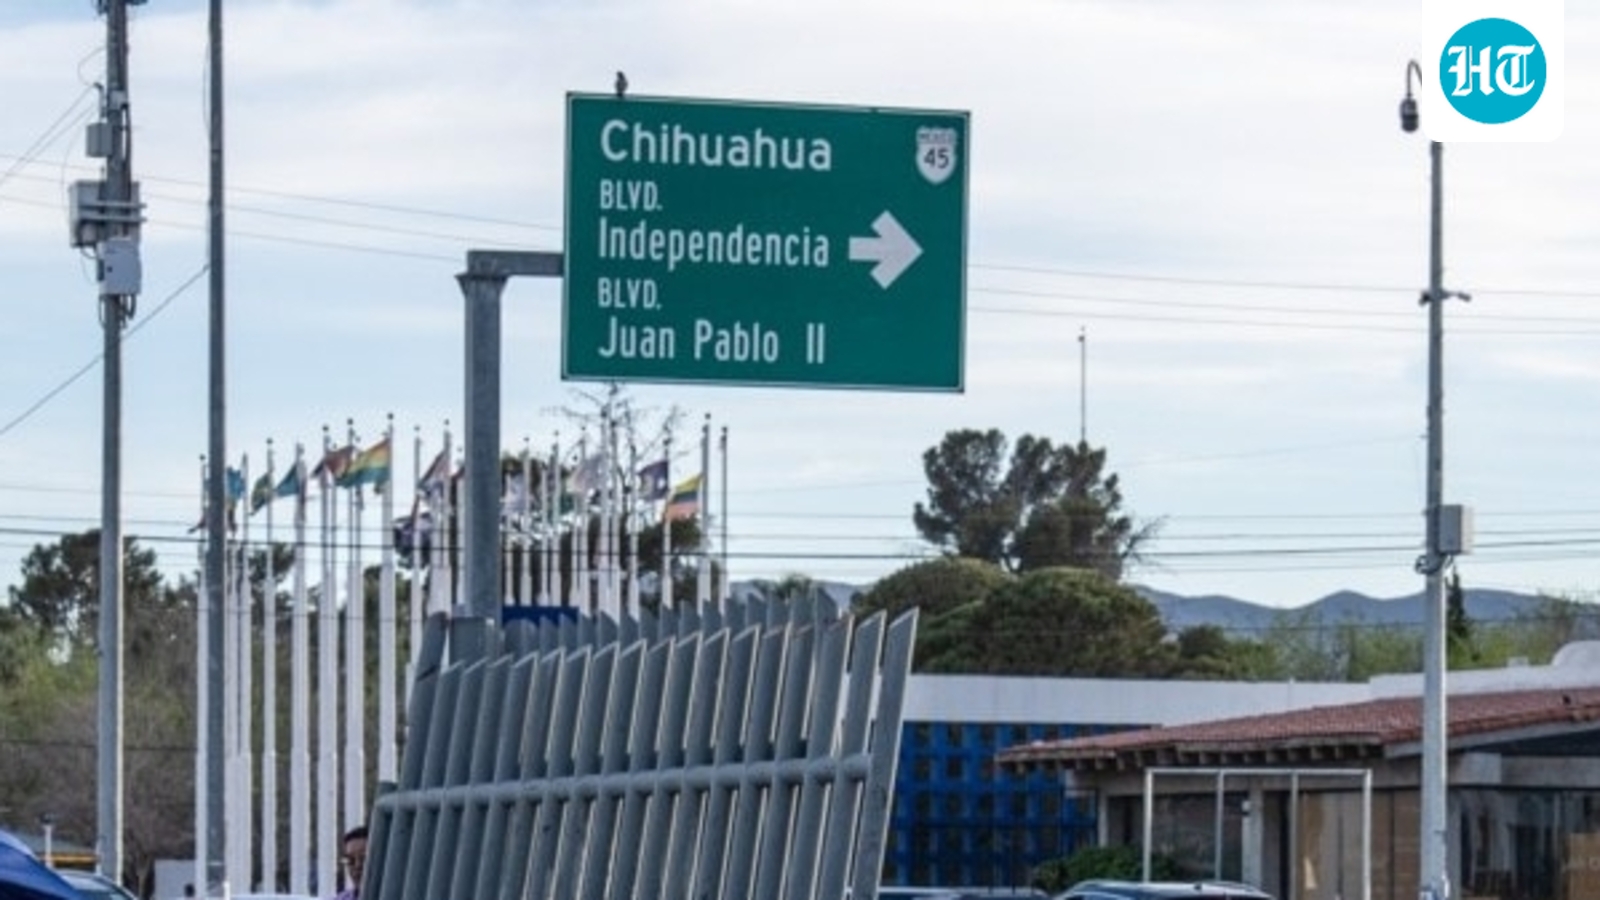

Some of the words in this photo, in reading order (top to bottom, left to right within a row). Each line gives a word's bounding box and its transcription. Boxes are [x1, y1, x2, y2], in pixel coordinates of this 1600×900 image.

[601, 120, 832, 170] Chihuahua
[924, 147, 949, 169] 45
[600, 180, 662, 211] BLVD.
[599, 217, 829, 271] Independencia
[598, 277, 661, 310] BLVD.
[598, 317, 675, 358] Juan
[694, 319, 779, 362] Pablo
[806, 322, 825, 364] II
